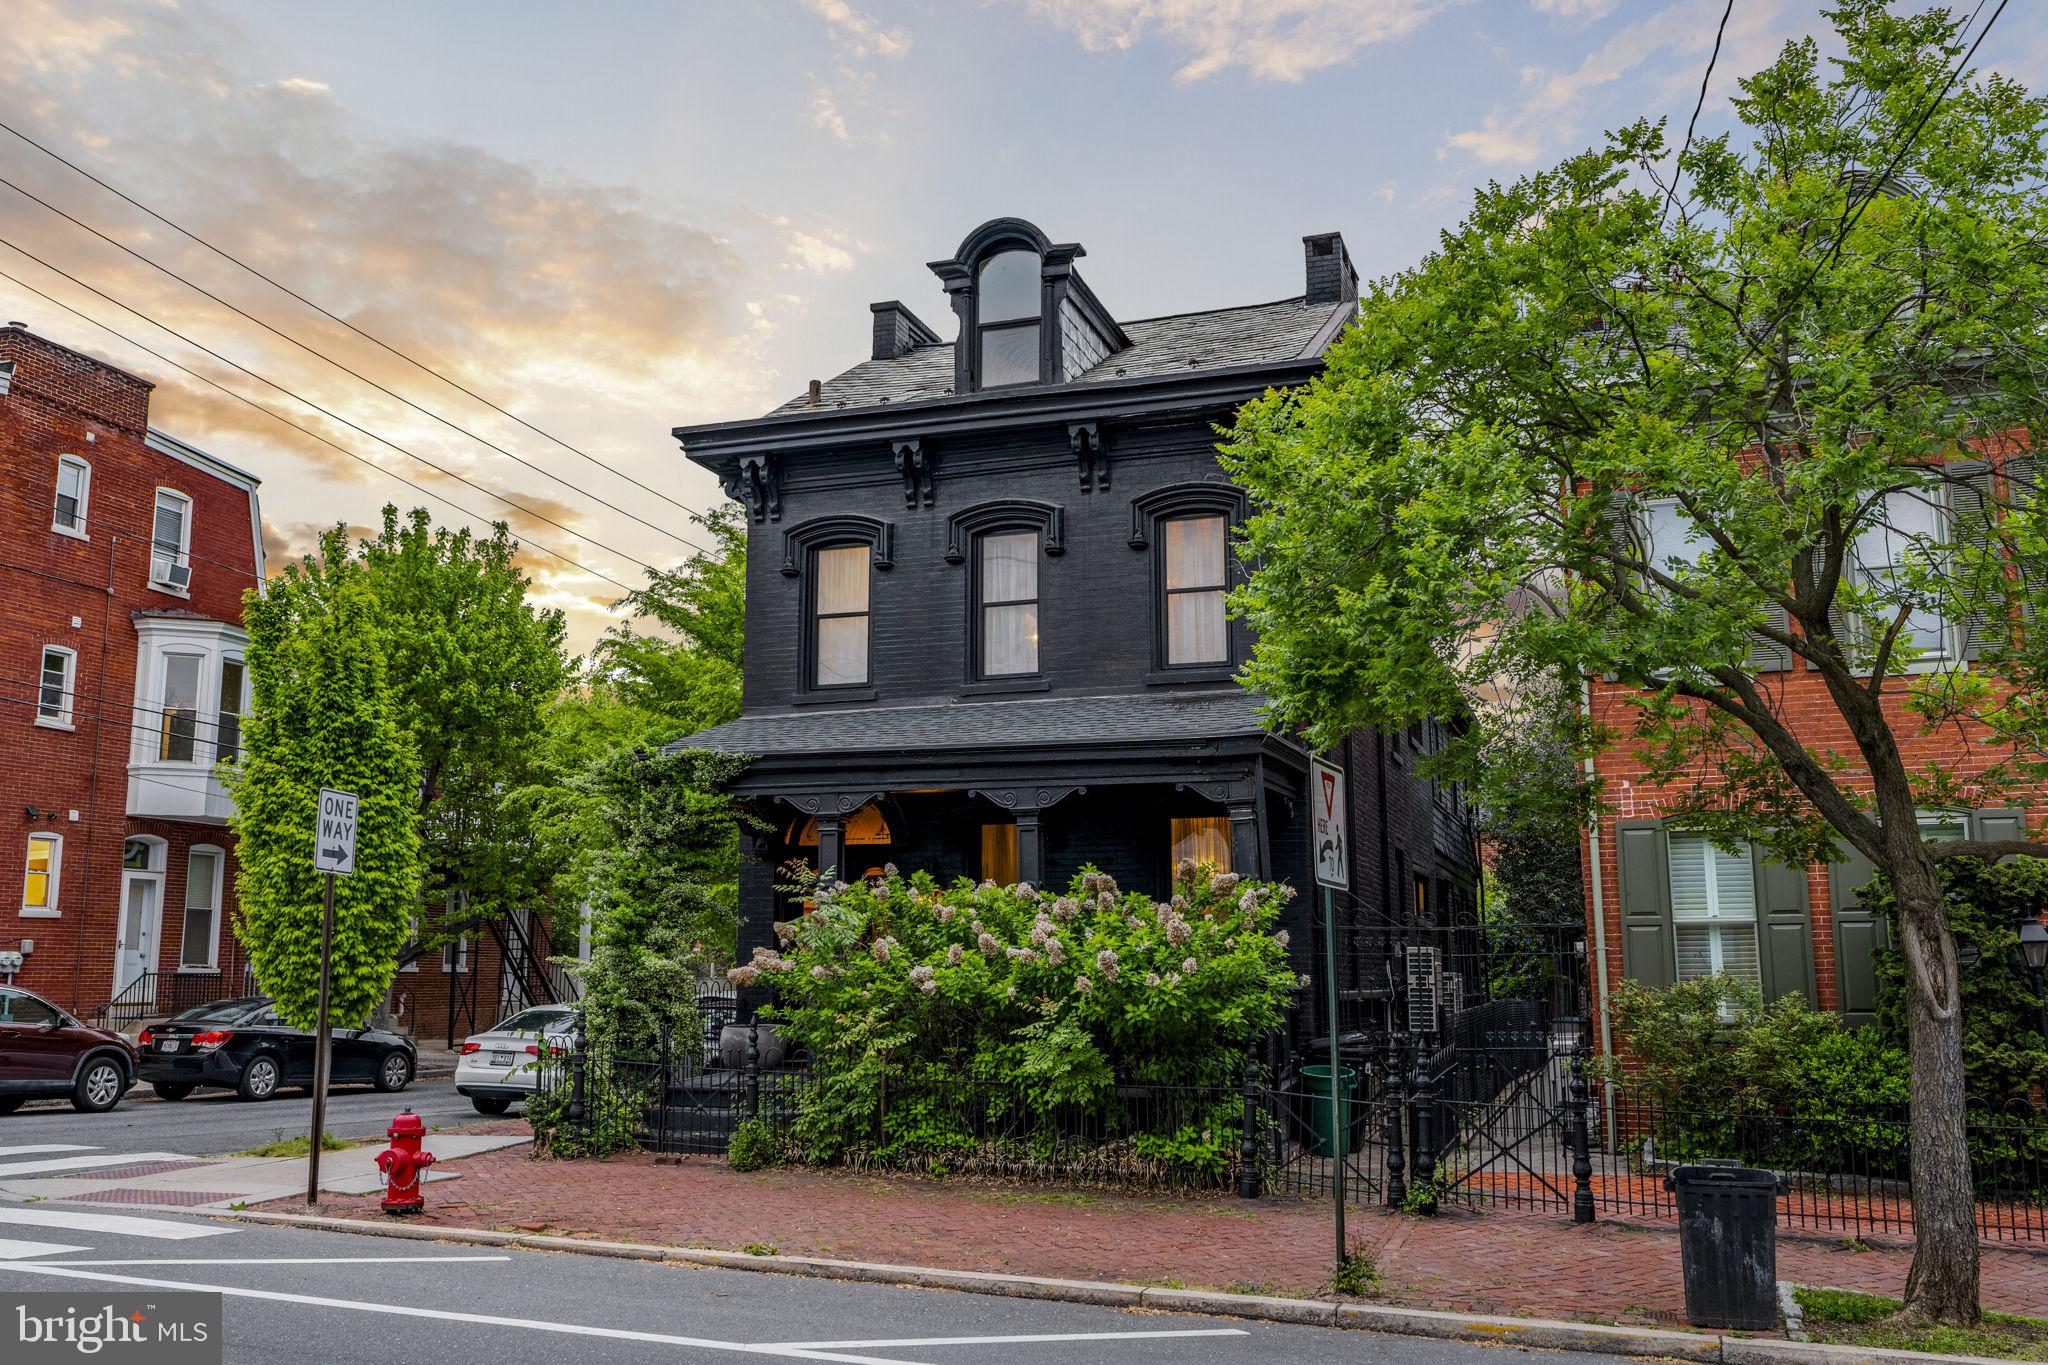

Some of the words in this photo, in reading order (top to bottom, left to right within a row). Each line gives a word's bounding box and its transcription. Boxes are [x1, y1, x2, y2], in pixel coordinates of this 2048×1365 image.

[325, 797, 353, 819] ONE
[323, 819, 353, 841] WAY
[1317, 817, 1328, 835] HERE
